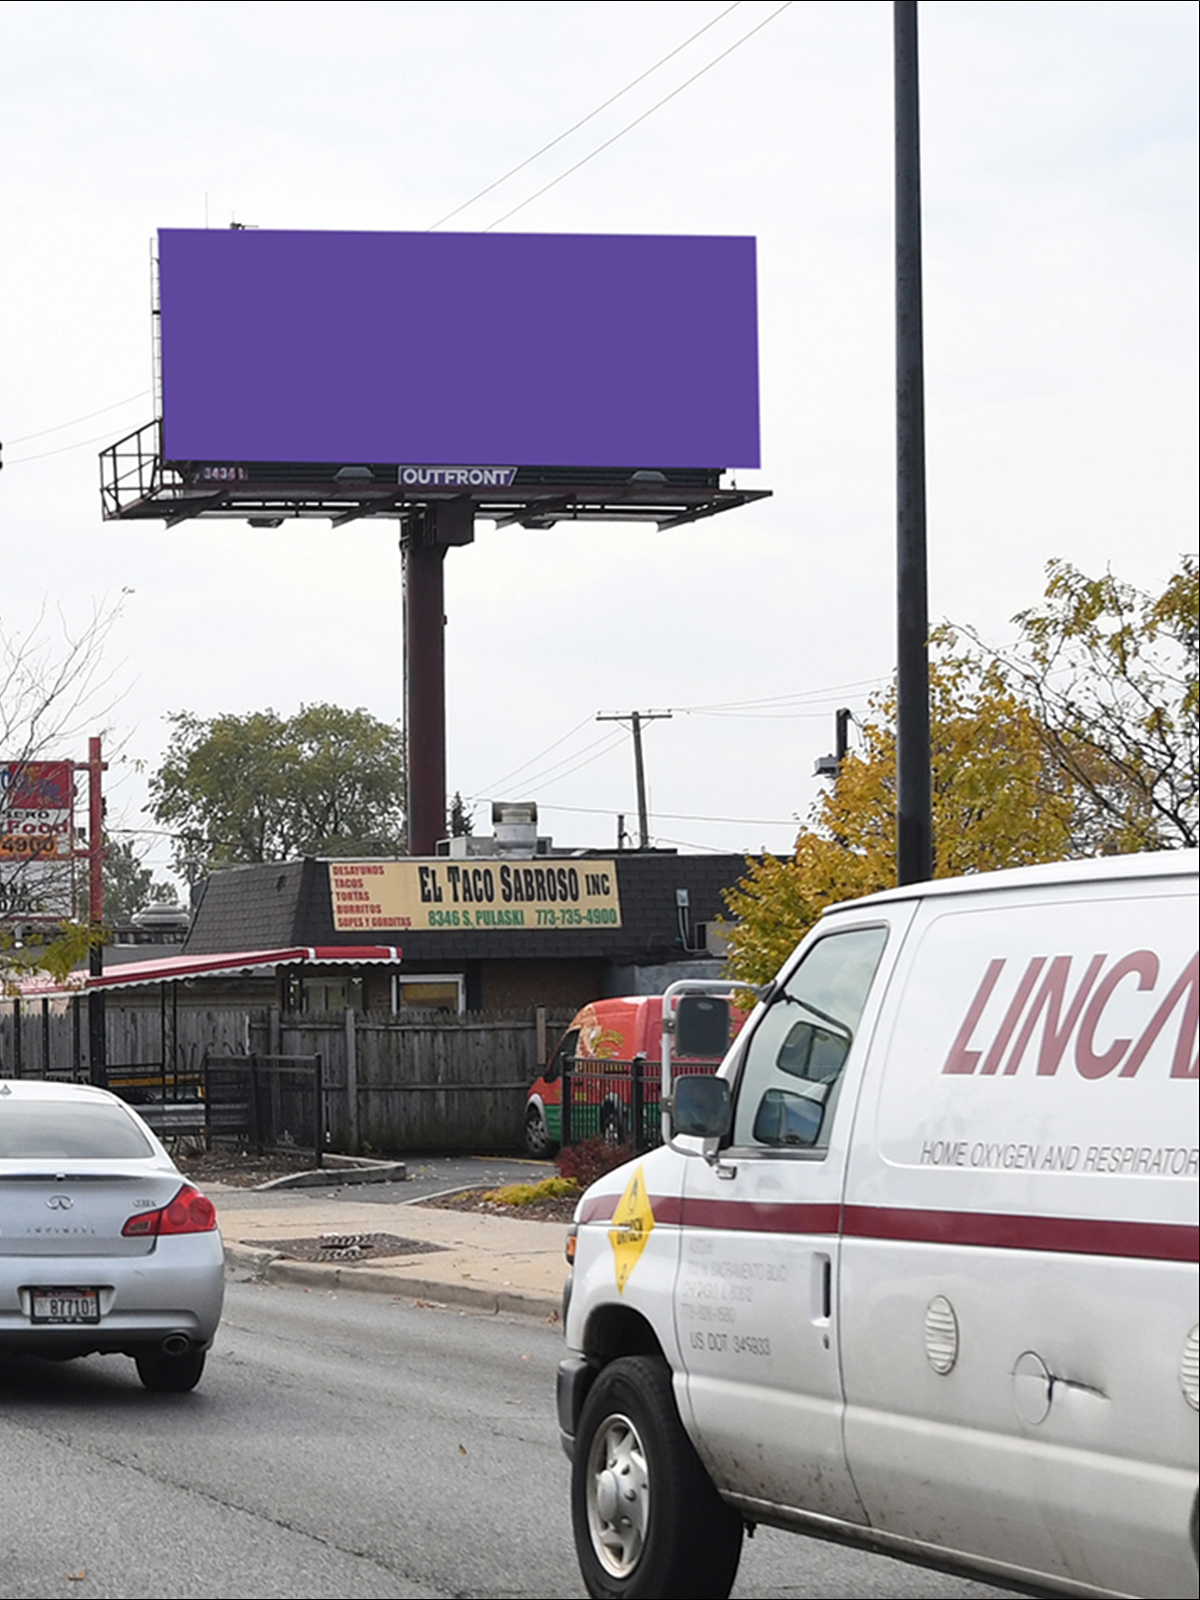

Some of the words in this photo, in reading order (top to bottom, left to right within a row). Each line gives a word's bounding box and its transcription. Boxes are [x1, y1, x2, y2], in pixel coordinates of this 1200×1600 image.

[402, 468, 508, 485] OUTFRONT
[8, 820, 68, 834] Food
[333, 865, 385, 876] DESAYUNOS
[334, 878, 364, 888] TACOS
[418, 866, 443, 902] EL
[447, 866, 494, 902] TACO
[500, 865, 579, 902] SABROSO
[585, 873, 610, 896] INC
[336, 891, 370, 901] TORTAS
[336, 904, 382, 914] BURRITOS
[338, 917, 364, 927] SOPES
[371, 917, 412, 927] GORDITAS
[428, 910, 460, 926] 8346
[475, 909, 525, 926] PULASKI
[535, 908, 618, 925] 773-735-4900
[920, 1141, 968, 1166] HOME
[970, 1142, 1039, 1169] OXYGEN
[1041, 1145, 1081, 1171] AND
[50, 1299, 89, 1315] 87710
[690, 1332, 705, 1350] US
[708, 1332, 728, 1352] DOT
